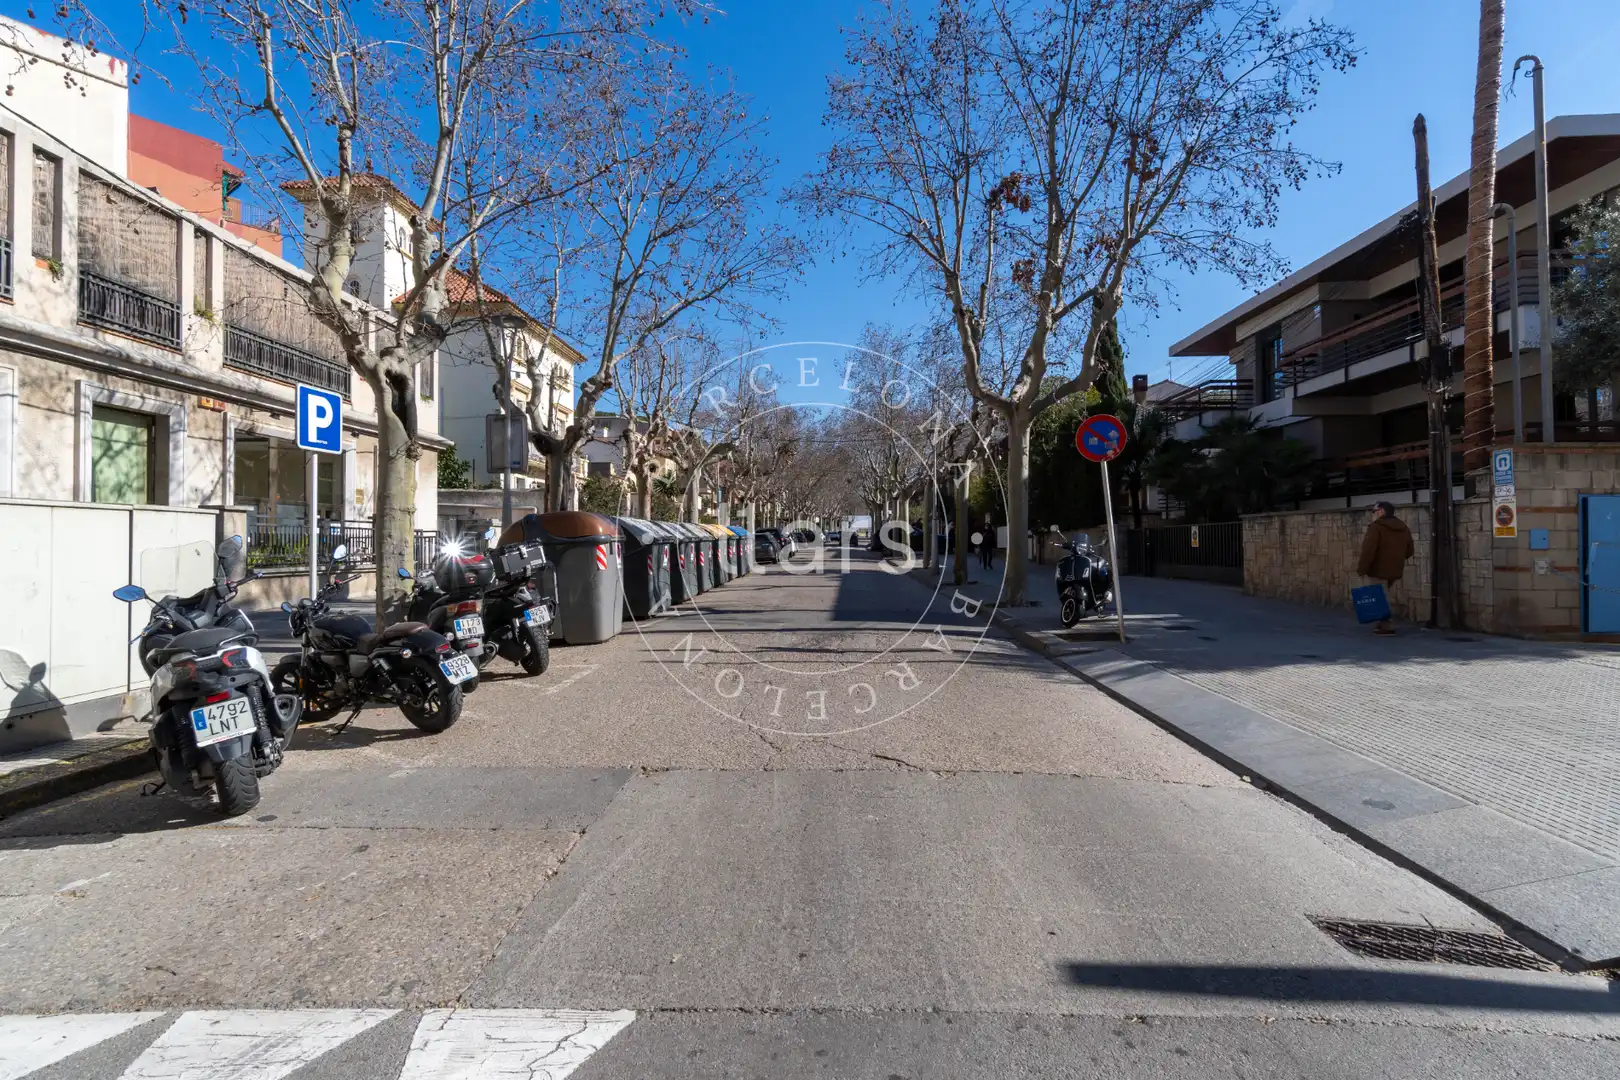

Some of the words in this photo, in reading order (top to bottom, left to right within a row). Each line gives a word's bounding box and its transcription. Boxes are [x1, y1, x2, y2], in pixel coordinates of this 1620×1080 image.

[308, 394, 334, 443] P
[447, 656, 470, 670] 9328
[208, 700, 248, 720] 4792
[209, 715, 239, 736] LNT
